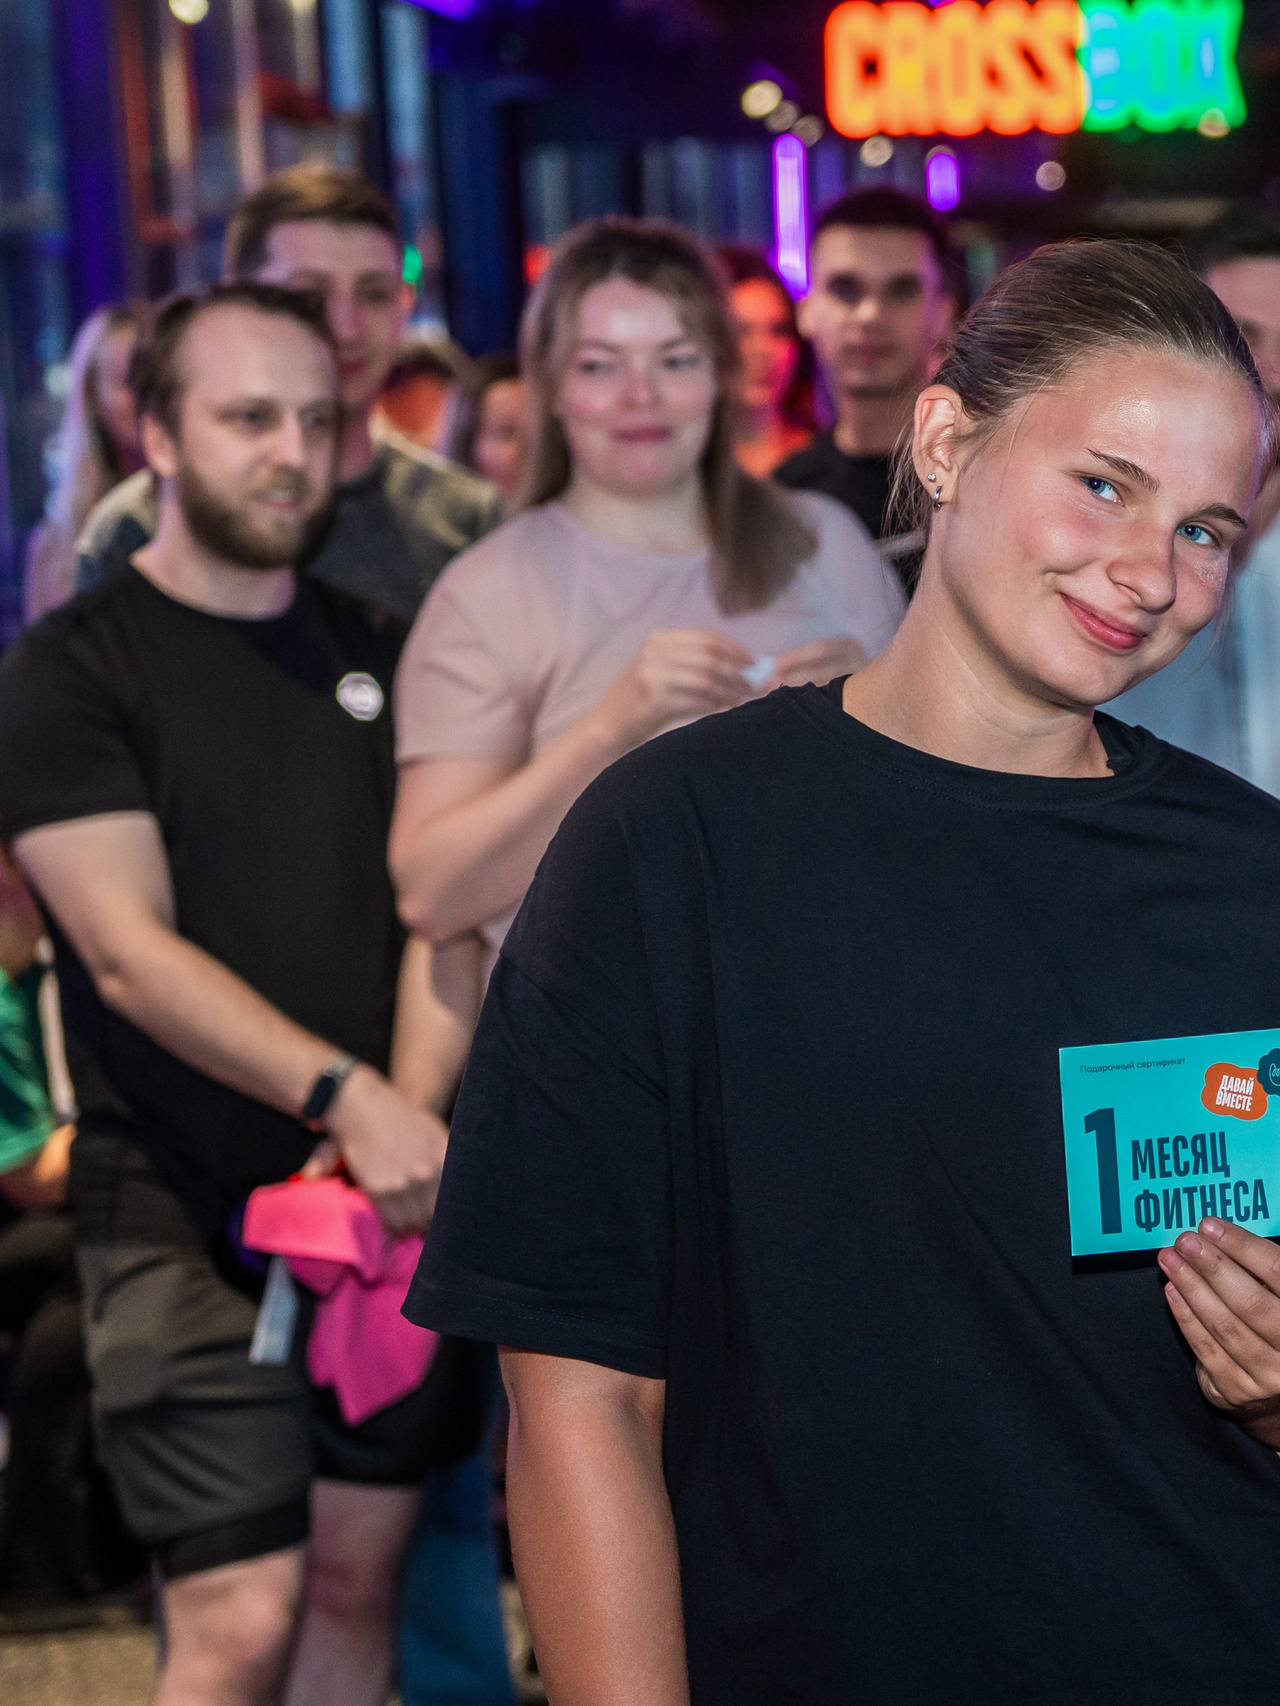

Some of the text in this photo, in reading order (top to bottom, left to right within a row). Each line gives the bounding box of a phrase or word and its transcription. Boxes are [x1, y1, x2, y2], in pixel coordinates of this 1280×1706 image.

[1079, 1058, 1186, 1074] Подарочный сертификат
[1215, 1089, 1253, 1112] ВМЕСТЕ
[1218, 1074, 1255, 1096] ДАВАЙ
[1084, 1107, 1122, 1235] 1
[1131, 1131, 1231, 1181] МЕСЯЦ
[1134, 1178, 1270, 1233] ФИТНЕСА
